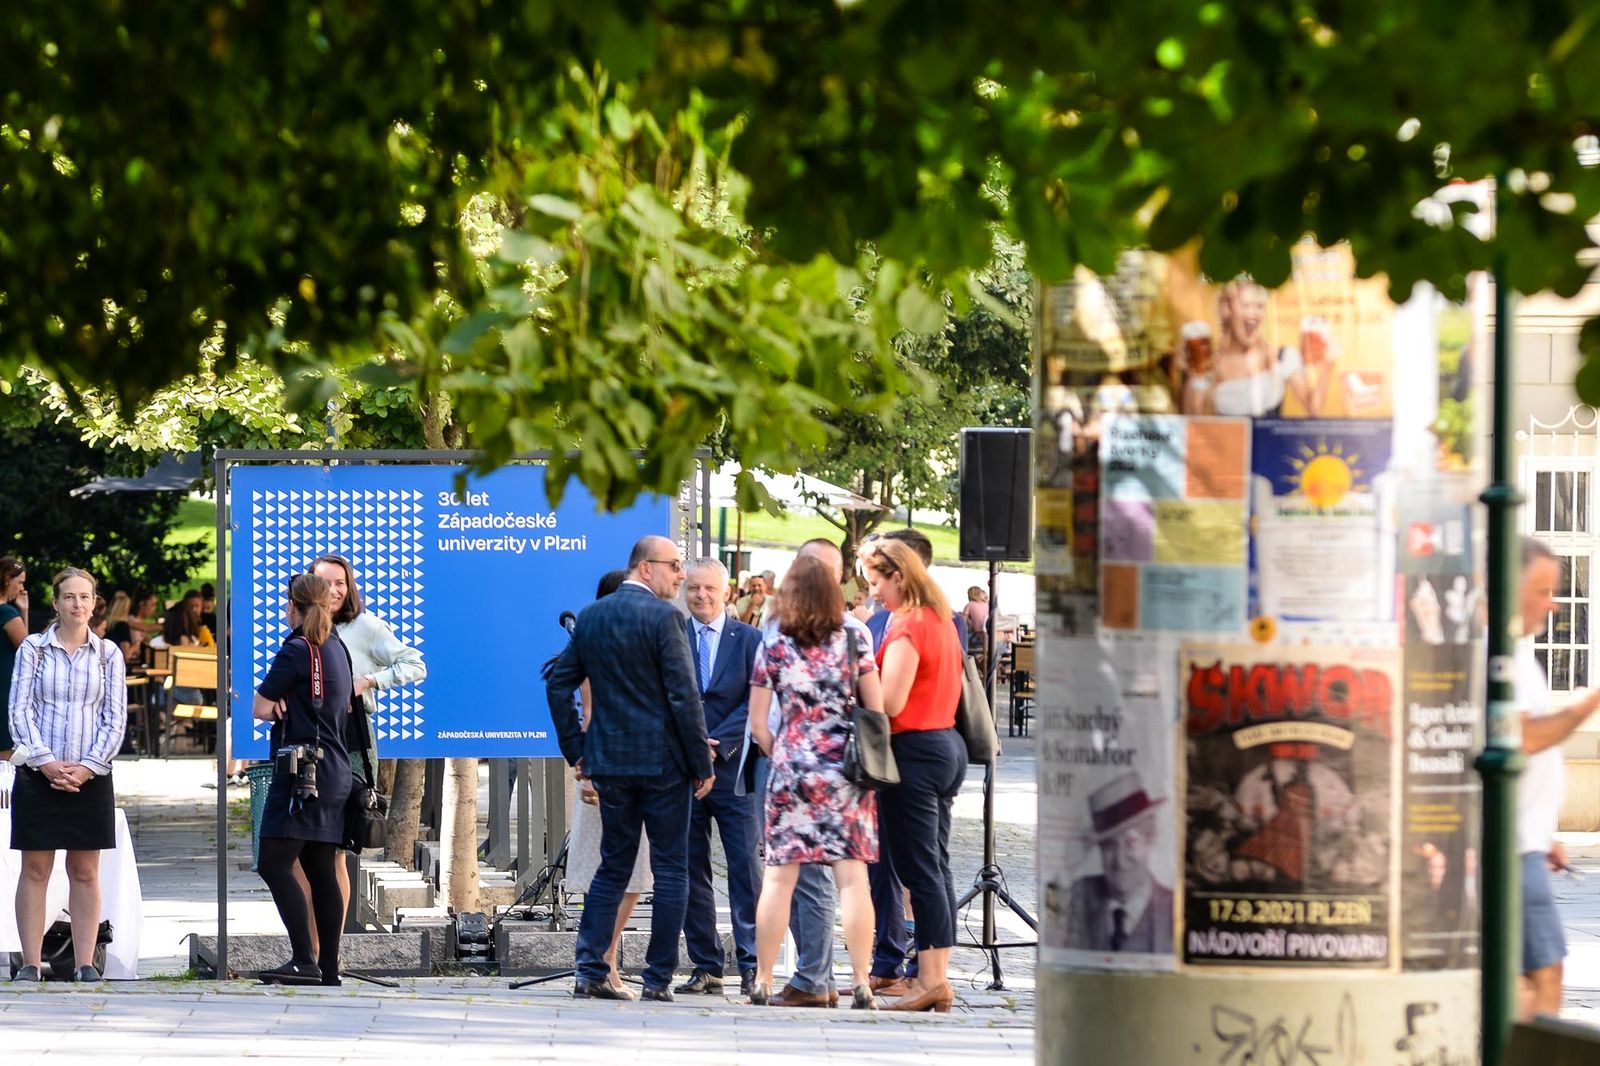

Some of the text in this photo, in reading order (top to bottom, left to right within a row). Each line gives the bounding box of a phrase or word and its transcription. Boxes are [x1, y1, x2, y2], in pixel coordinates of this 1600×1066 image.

[466, 490, 490, 507] let
[438, 511, 557, 532] Západočeské
[438, 534, 587, 554] univerzity v Plzni
[437, 730, 484, 739] ZÁPADOČESKÁ
[485, 731, 521, 739] UNIVERZITA
[528, 731, 547, 739] PLZNI
[1210, 897, 1372, 925] 17.9.2021 PLZEŇ
[1189, 928, 1388, 958] NÁDVOŘÍ PIVOVARU
